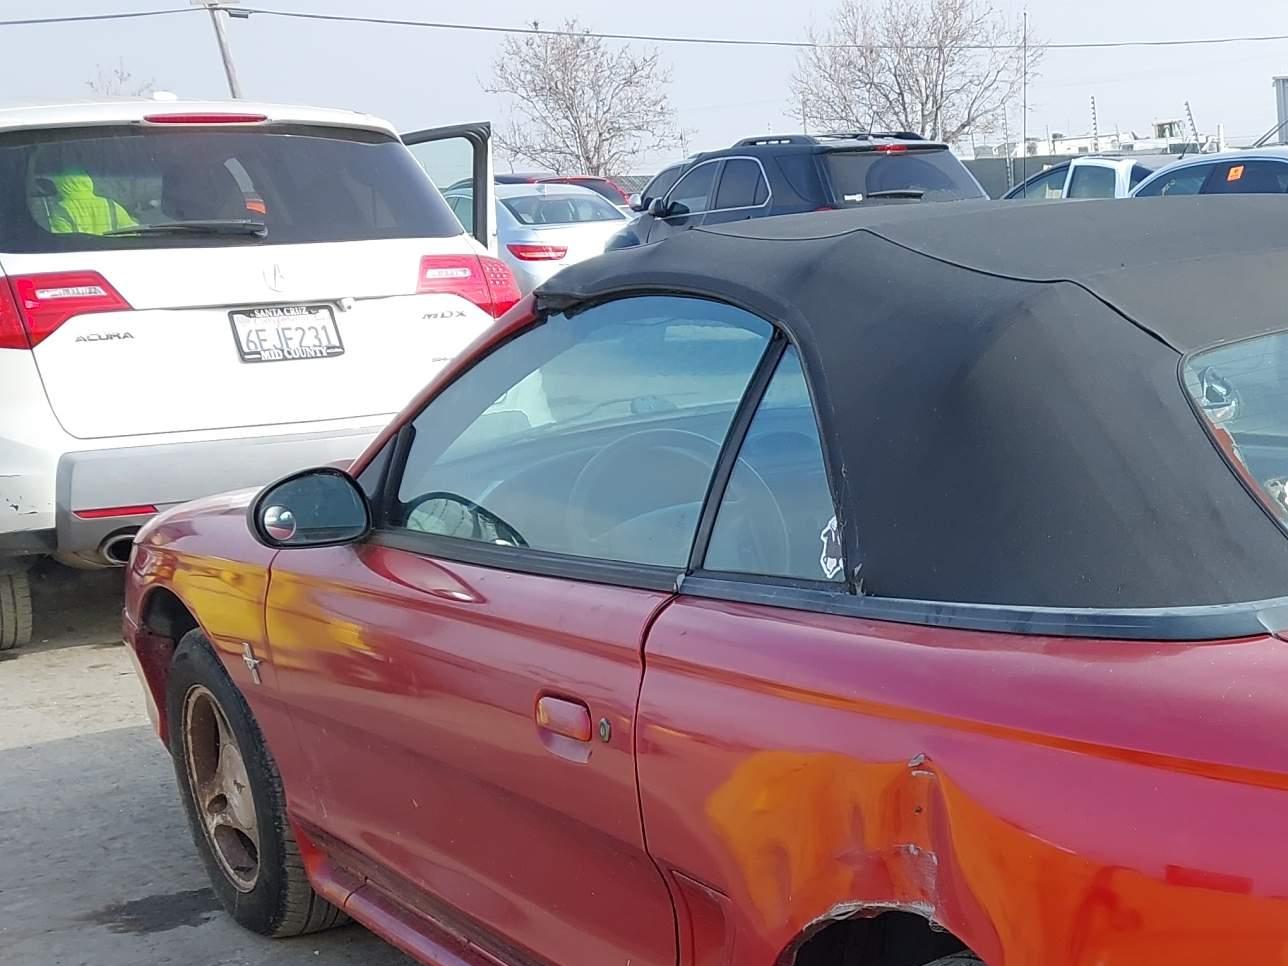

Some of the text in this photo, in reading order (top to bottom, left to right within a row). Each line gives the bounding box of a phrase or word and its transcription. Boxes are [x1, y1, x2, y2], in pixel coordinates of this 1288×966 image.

[254, 306, 309, 318] SANTA CRUZ
[421, 310, 467, 320] MDX
[75, 331, 135, 342] ACURA
[260, 346, 328, 360] MID COUNTY
